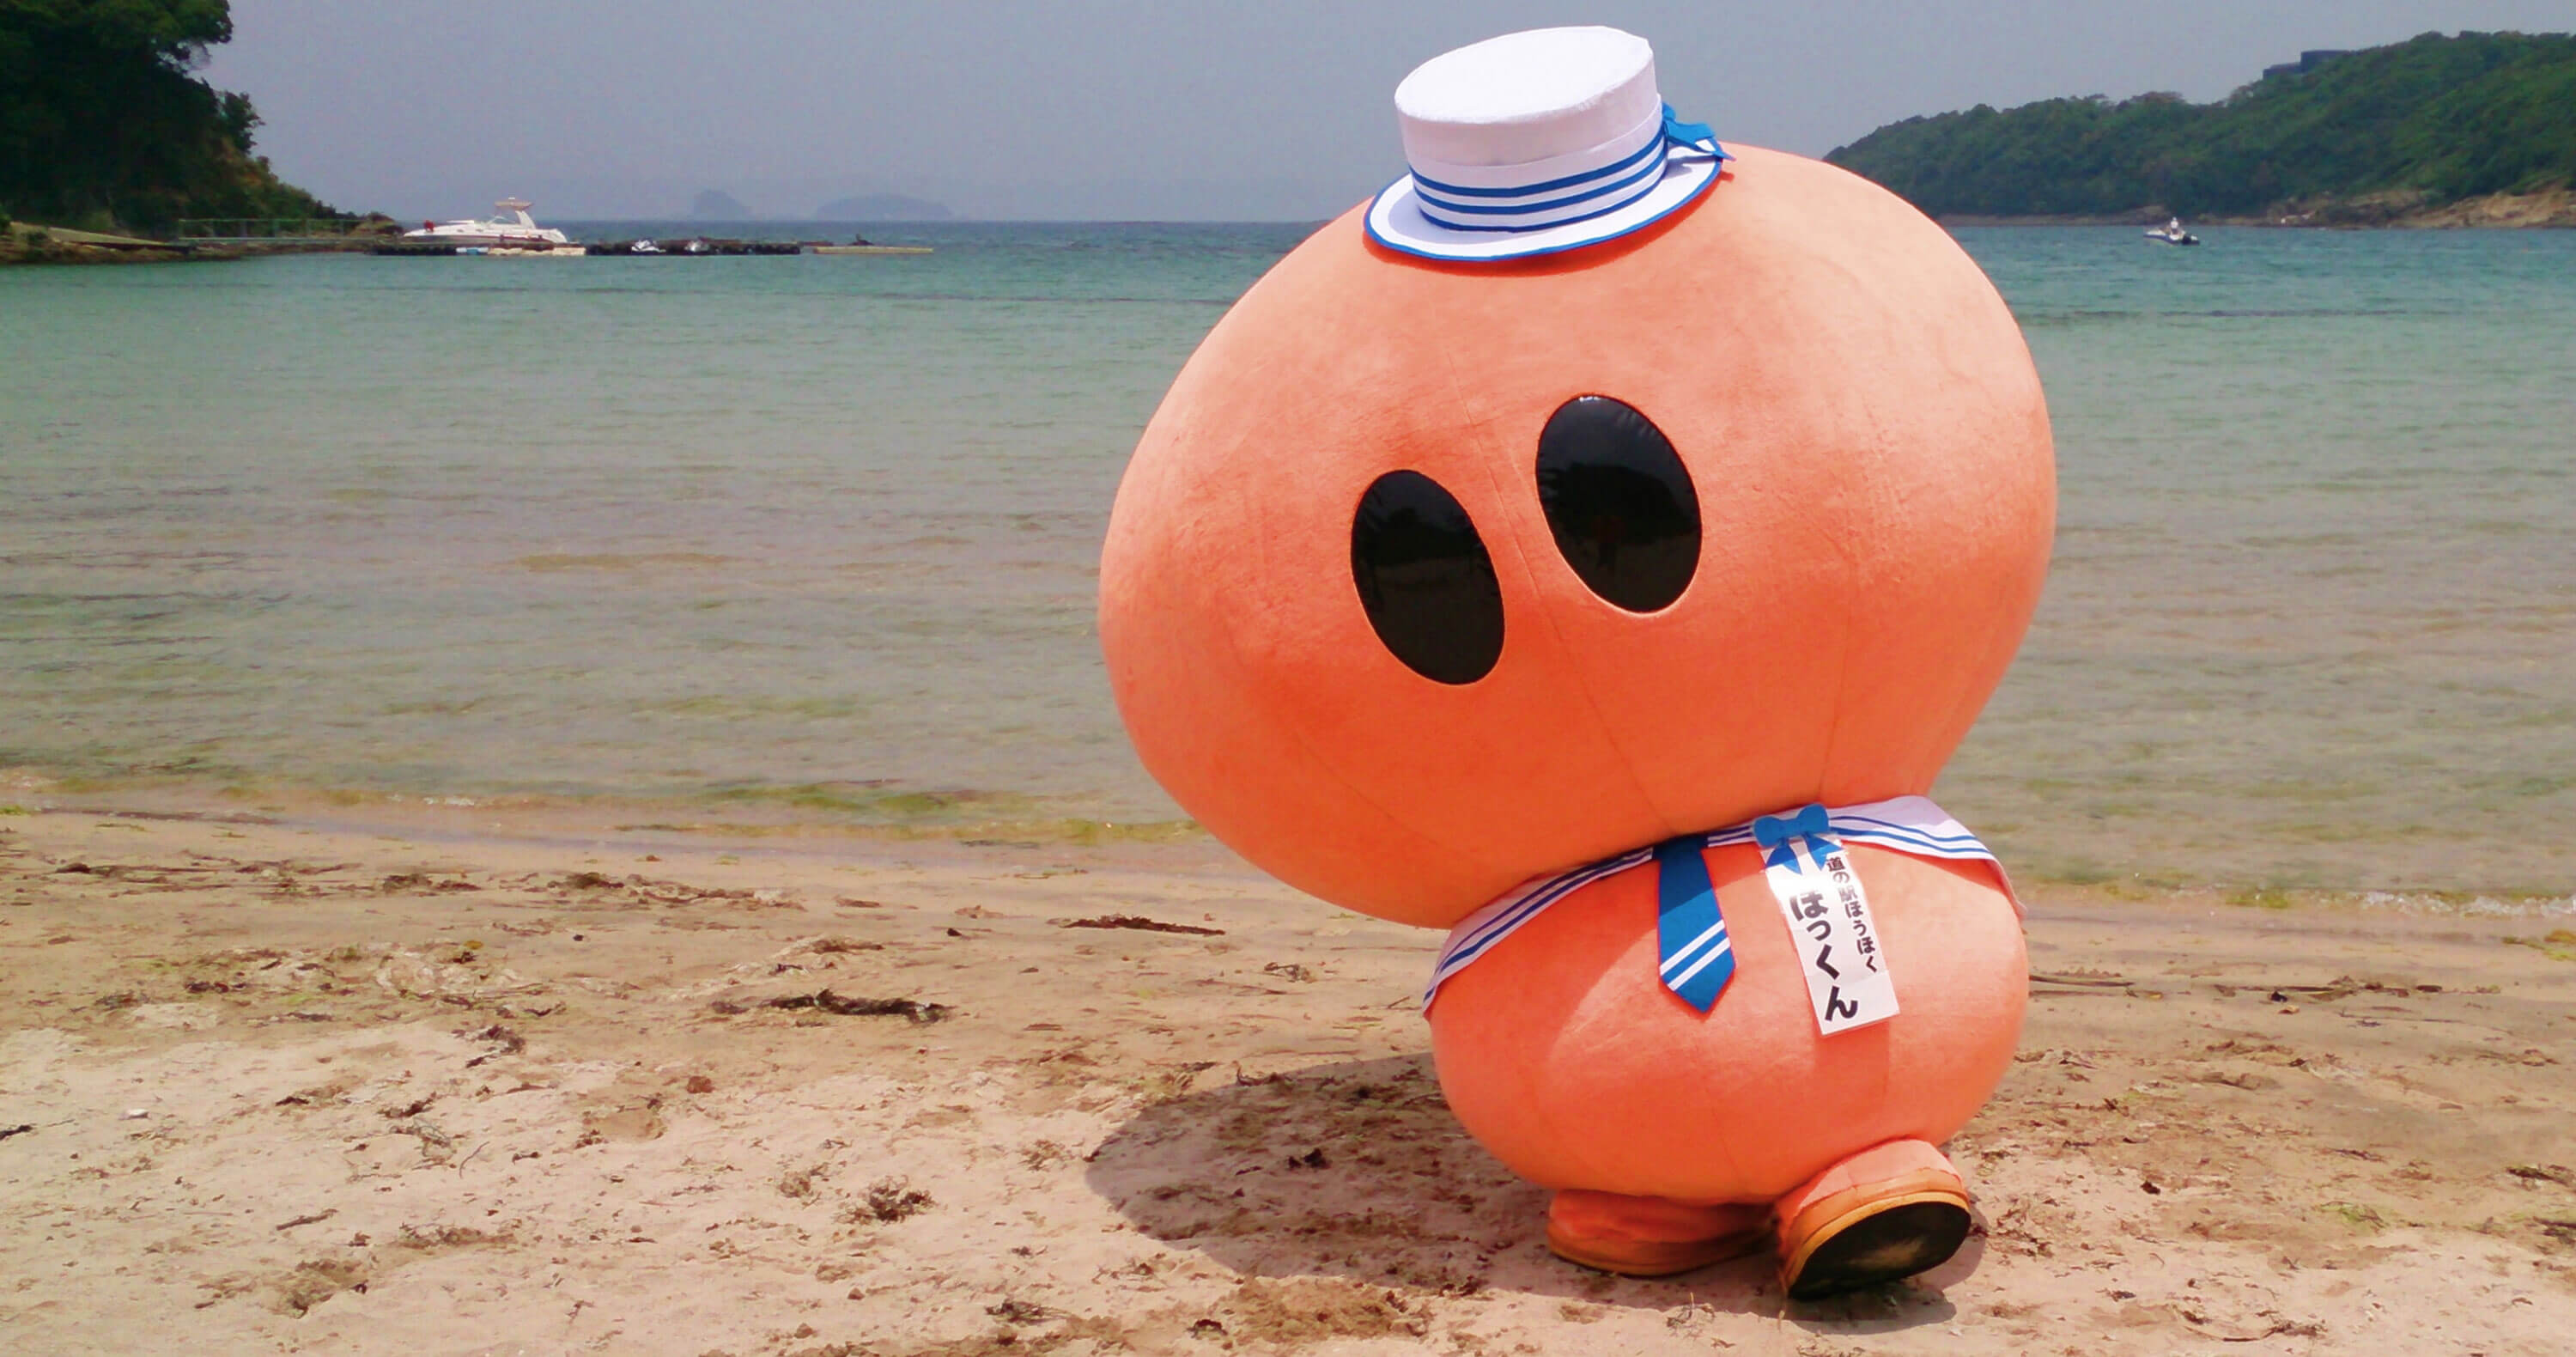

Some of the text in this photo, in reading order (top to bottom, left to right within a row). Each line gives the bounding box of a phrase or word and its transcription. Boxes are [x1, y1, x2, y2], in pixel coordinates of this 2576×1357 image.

[1826, 856, 1877, 972] 道の駅ほうほく
